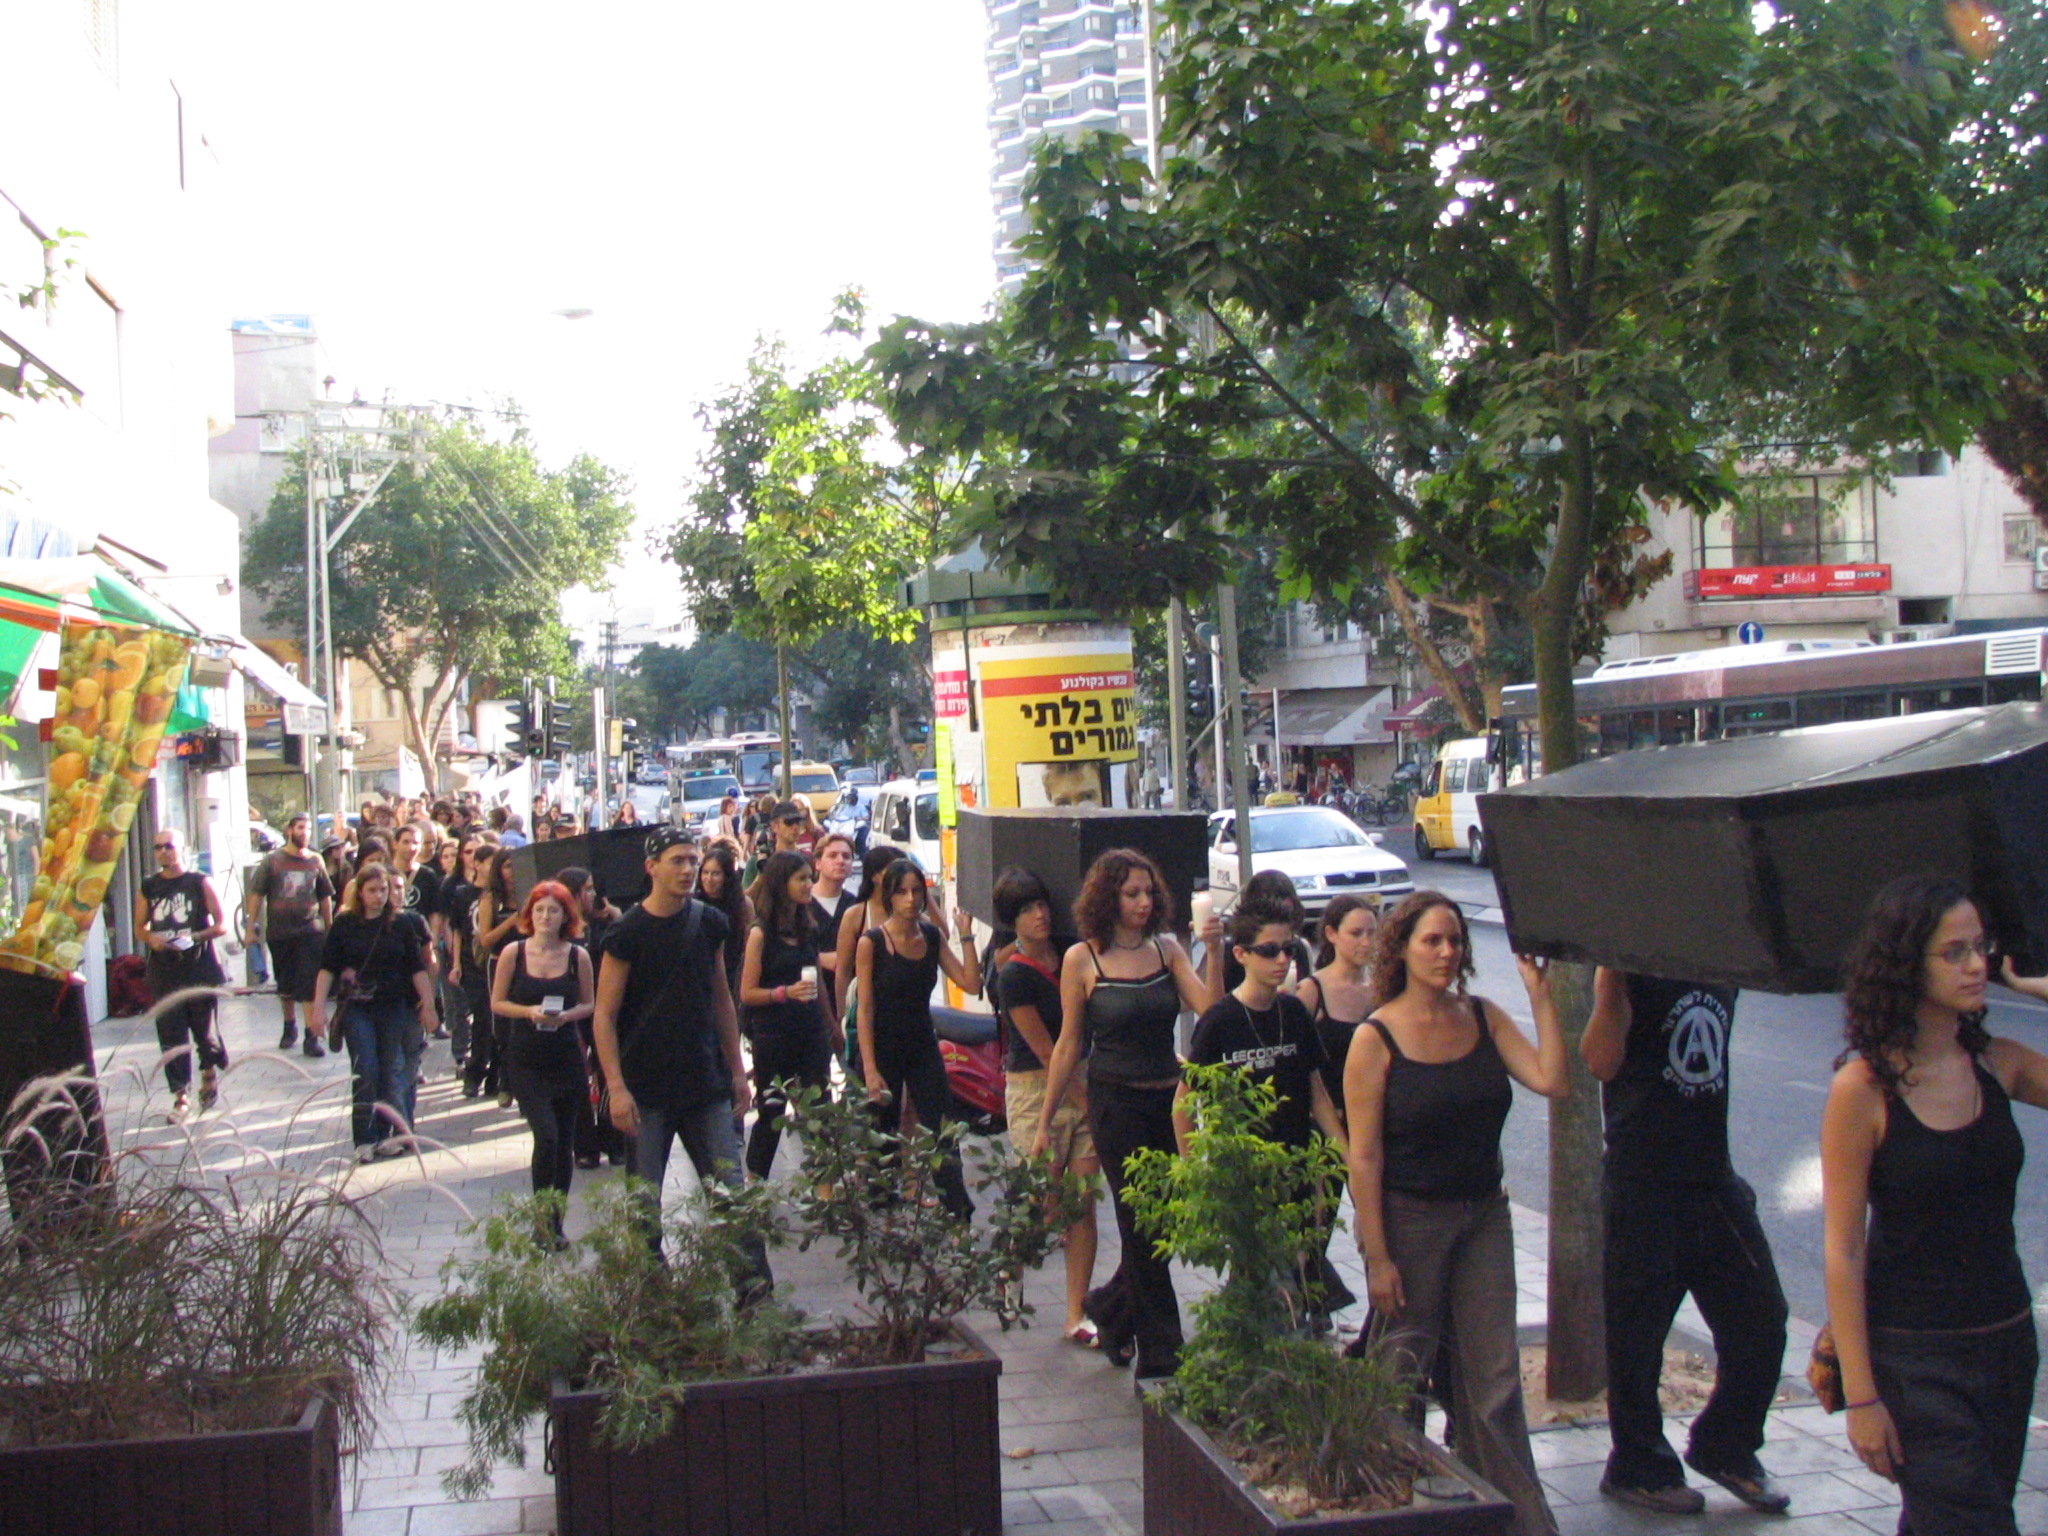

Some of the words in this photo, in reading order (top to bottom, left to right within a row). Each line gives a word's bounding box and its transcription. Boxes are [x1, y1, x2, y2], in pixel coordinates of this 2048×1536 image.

[1060, 675, 1105, 690] בקולנוע
[1020, 695, 1103, 728] בלתי
[1111, 697, 1134, 722] יים
[1050, 726, 1136, 756] גמורים
